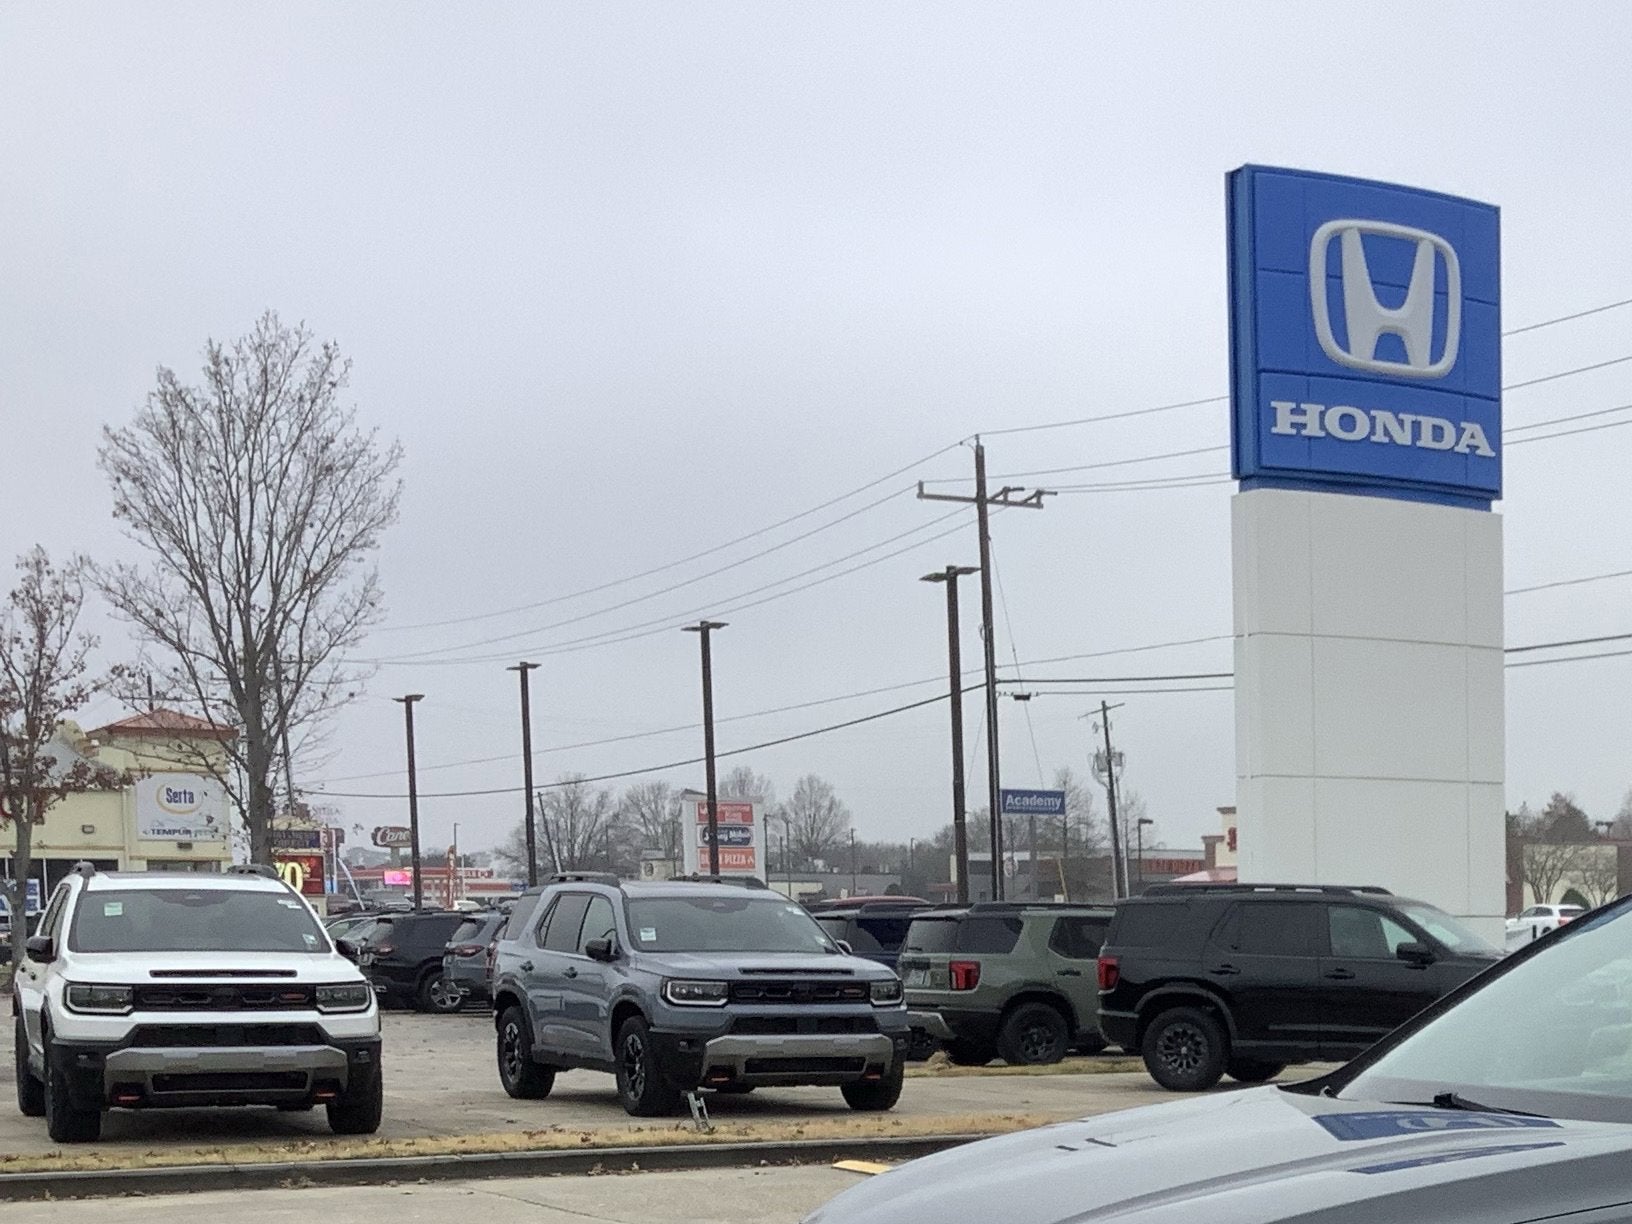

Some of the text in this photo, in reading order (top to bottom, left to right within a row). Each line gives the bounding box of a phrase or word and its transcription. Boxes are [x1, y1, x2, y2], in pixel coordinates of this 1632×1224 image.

[1270, 401, 1496, 457] HONDA
[165, 786, 195, 804] Serta
[1006, 794, 1061, 810] Academy
